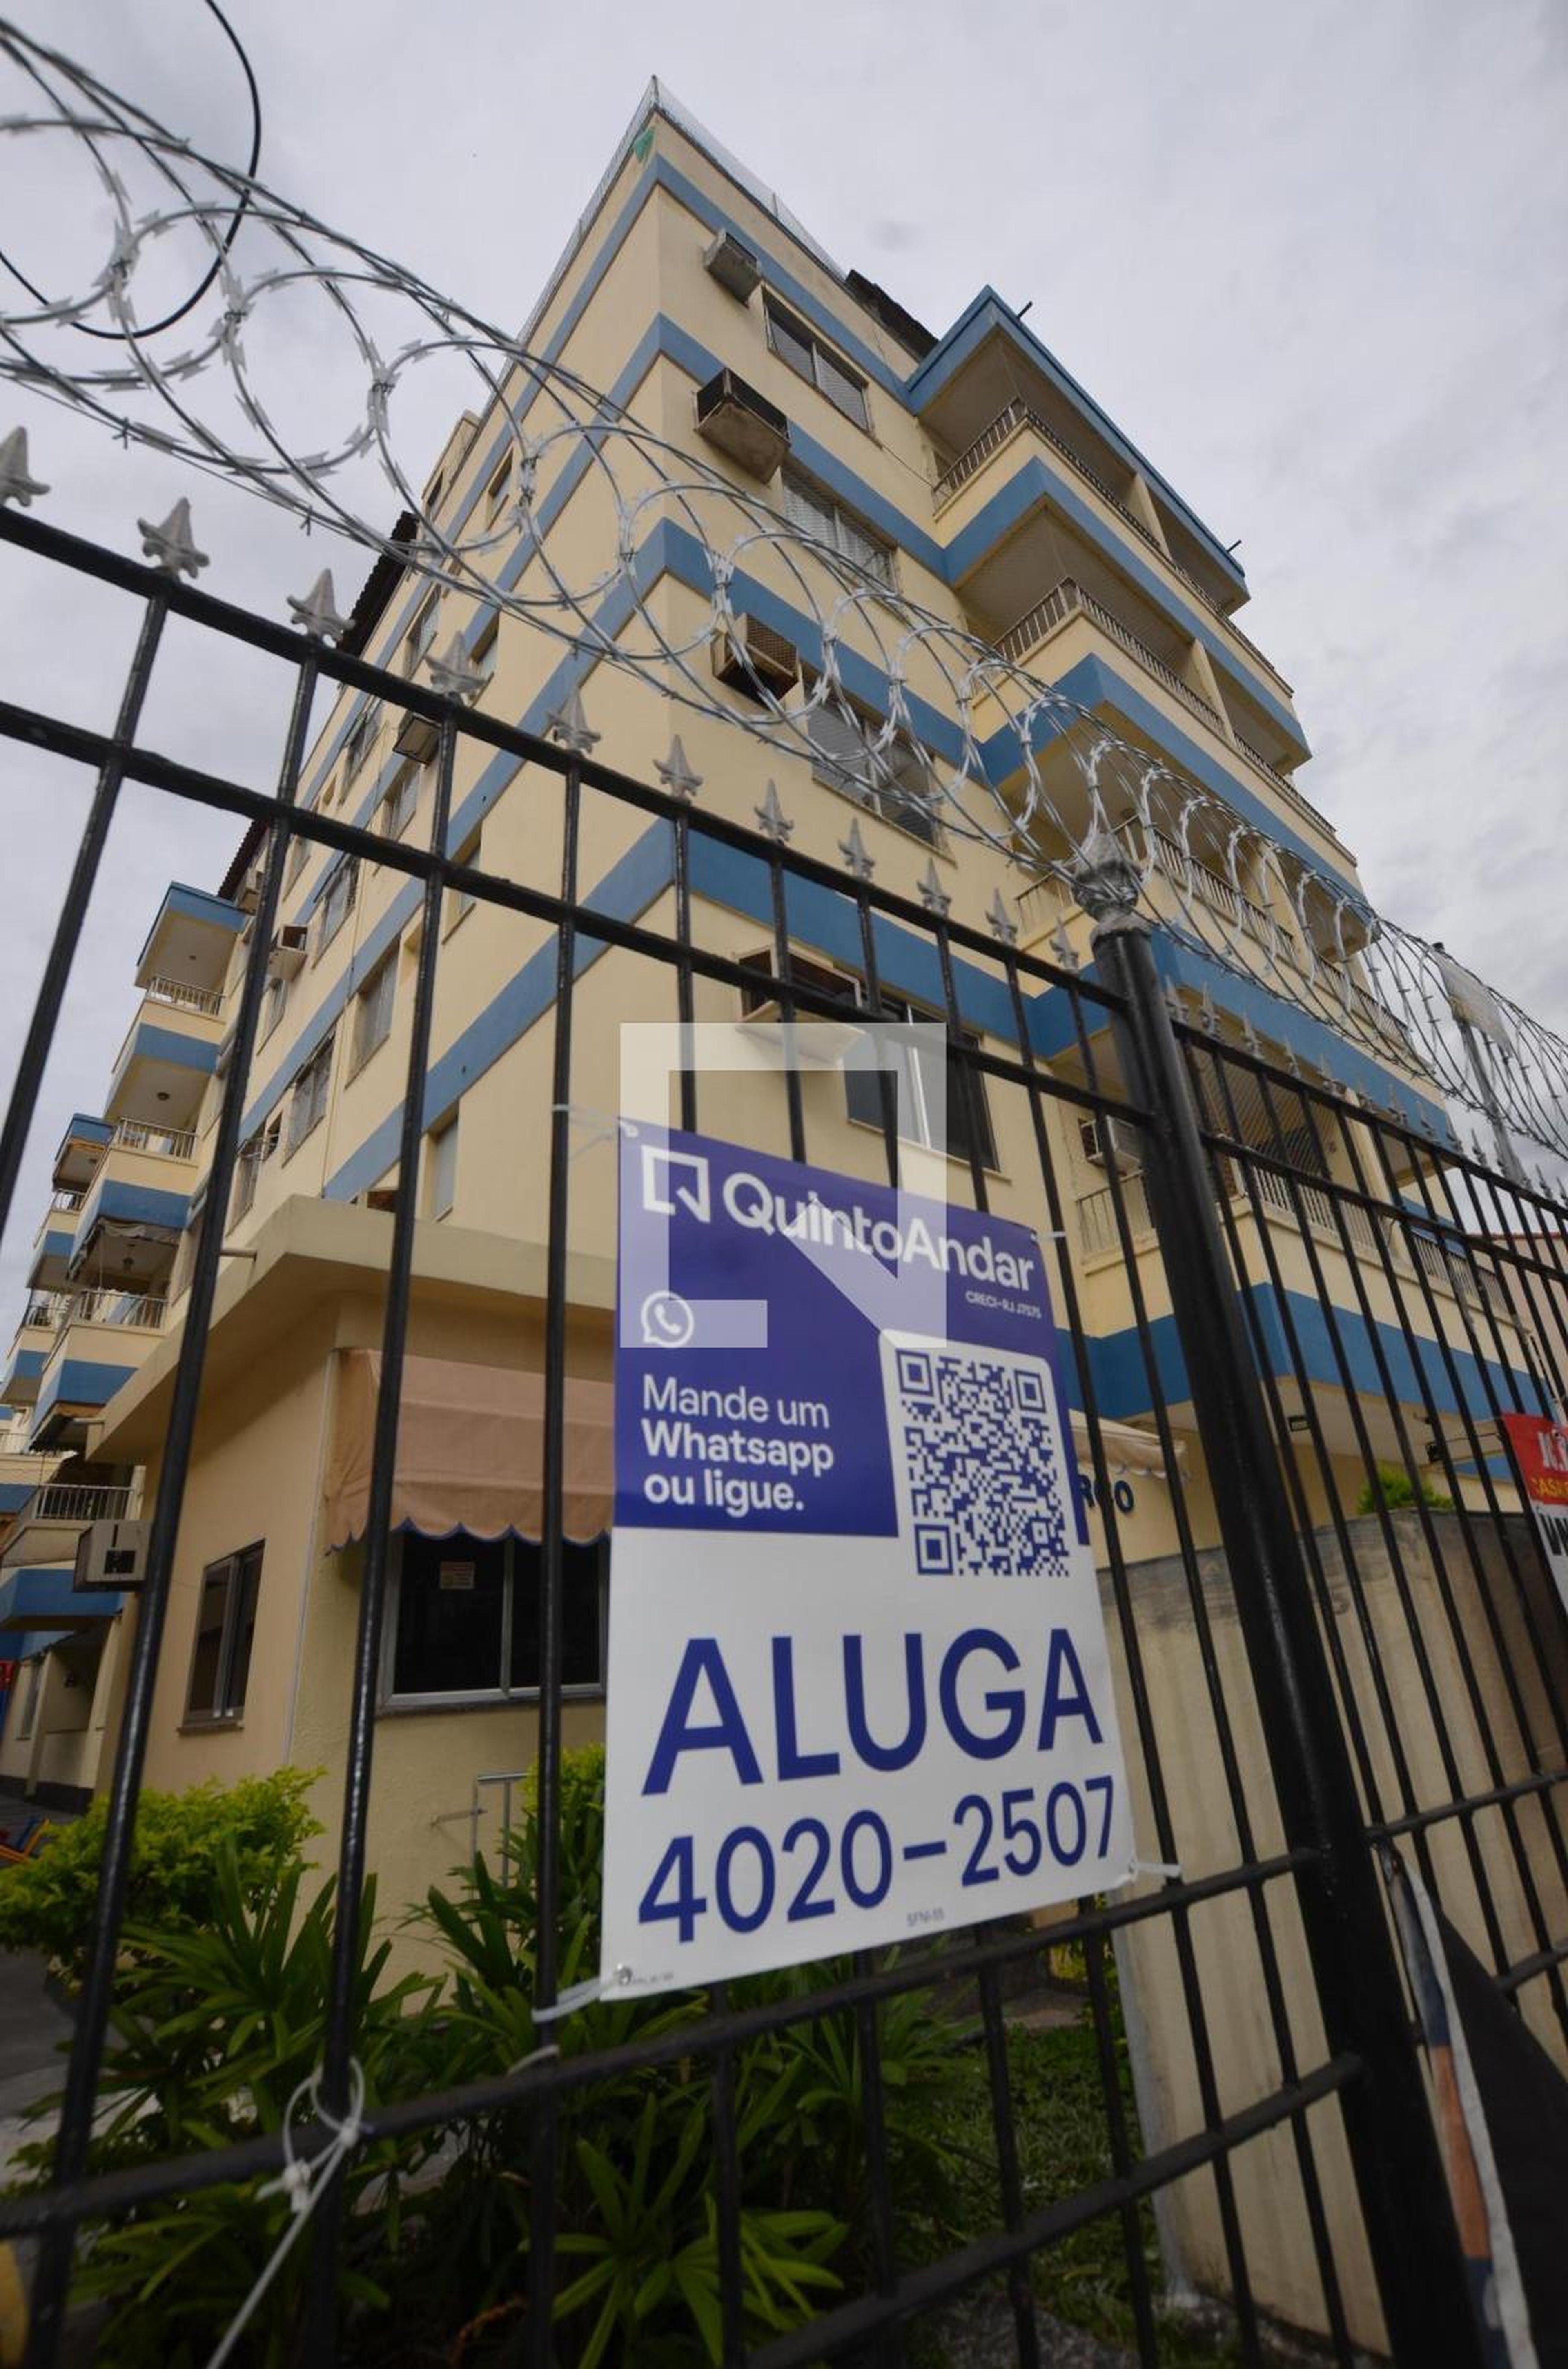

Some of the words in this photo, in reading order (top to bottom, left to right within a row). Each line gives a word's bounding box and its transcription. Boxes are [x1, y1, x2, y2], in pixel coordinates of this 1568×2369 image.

[723, 1173, 1034, 1290] QuintoAndar
[643, 1374, 769, 1423] Mande
[777, 1398, 830, 1429] um
[641, 1418, 834, 1477] Whatsapp
[644, 1474, 694, 1504] ou
[704, 1469, 804, 1518] ligue.
[641, 1627, 1105, 1797] ALUGA
[638, 1774, 1115, 1945] 4020-2507
